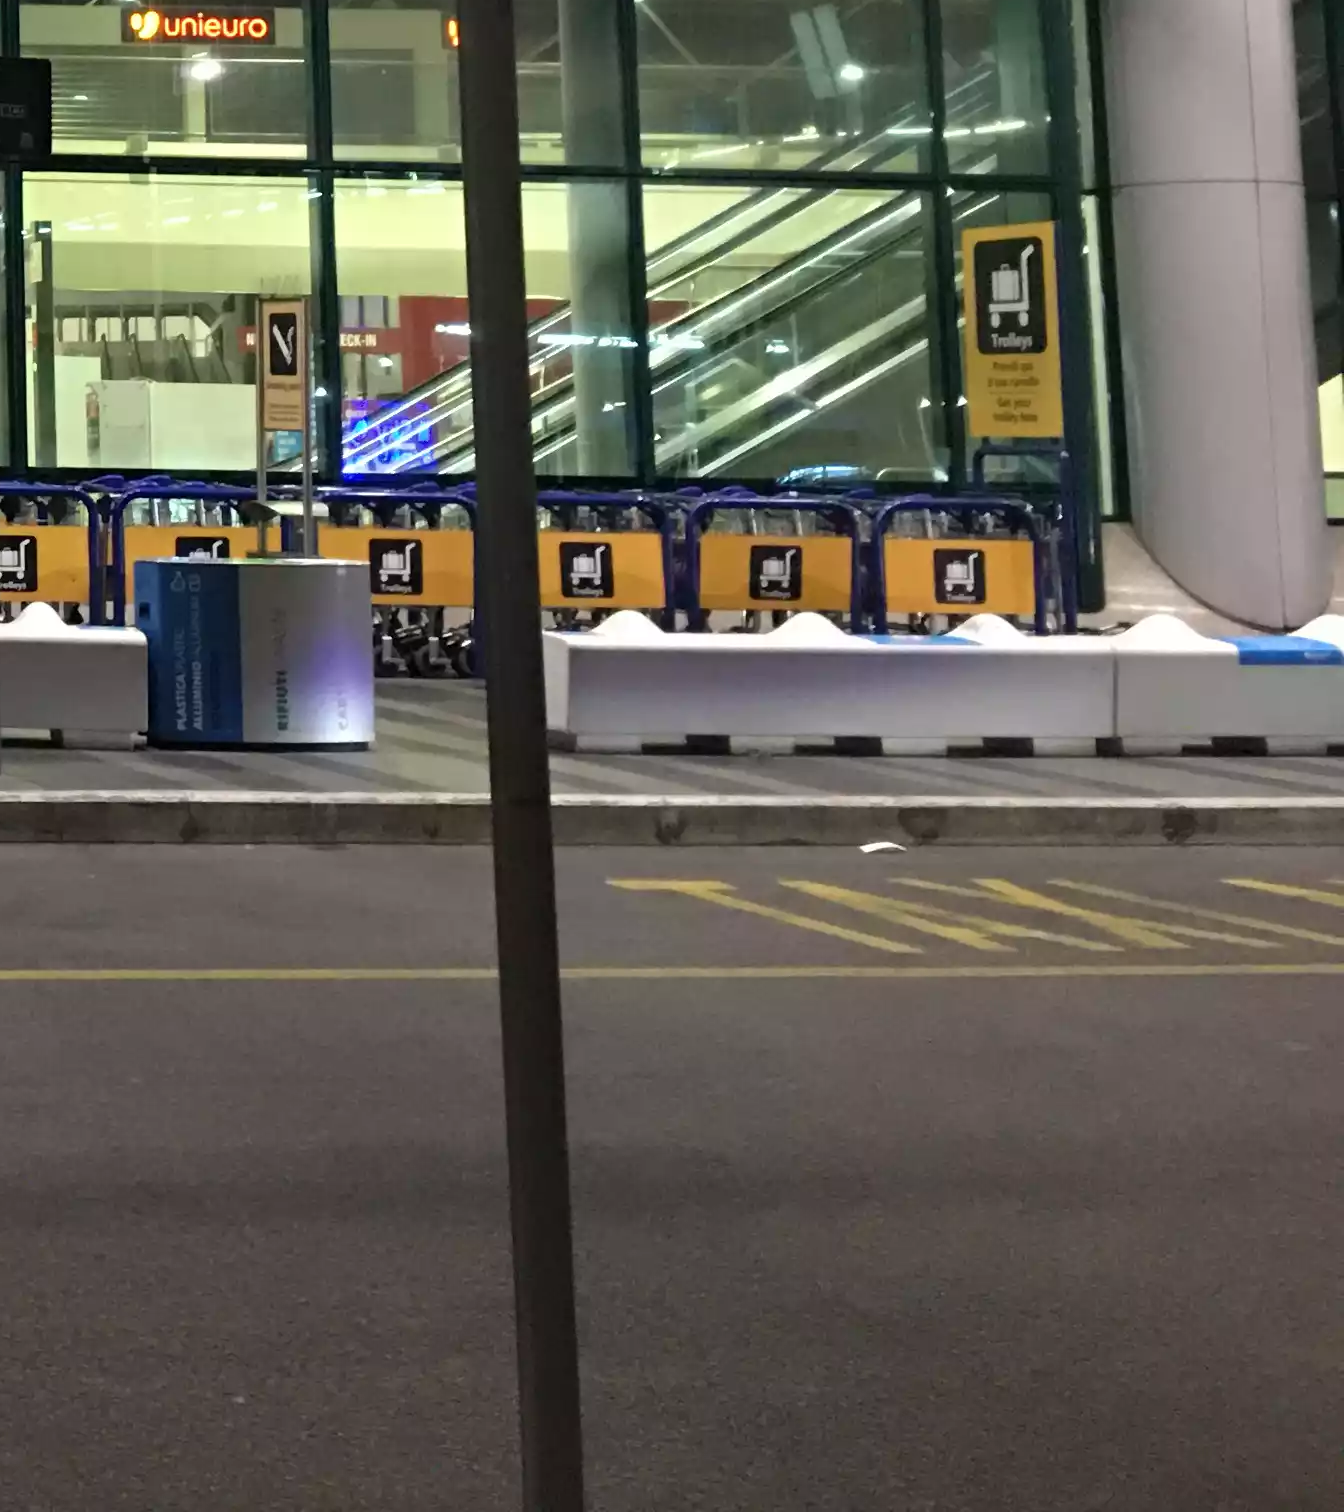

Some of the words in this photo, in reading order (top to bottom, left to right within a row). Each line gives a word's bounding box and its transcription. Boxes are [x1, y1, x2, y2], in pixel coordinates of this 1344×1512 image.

[164, 12, 268, 38] unieuro
[339, 333, 377, 347] ECK-IN
[990, 332, 1033, 351] Trolleys
[176, 673, 187, 731] PLASTICA
[192, 662, 203, 731] ALLUMINIO
[276, 670, 288, 731] RIFIUTI
